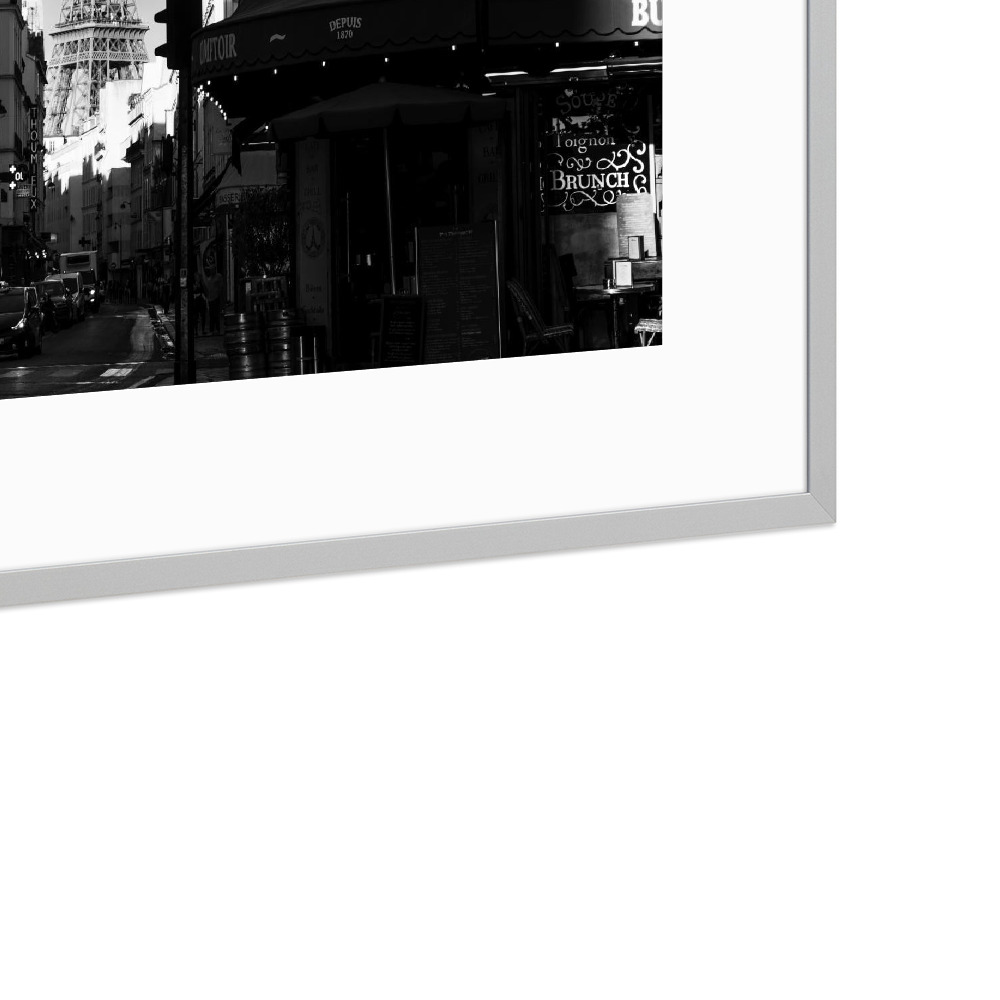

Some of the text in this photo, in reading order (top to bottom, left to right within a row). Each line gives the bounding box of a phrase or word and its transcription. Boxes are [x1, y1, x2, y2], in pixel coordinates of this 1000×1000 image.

[329, 16, 363, 32] DEPUIS
[336, 29, 353, 40] 1870
[551, 169, 630, 191] BRUNCH
